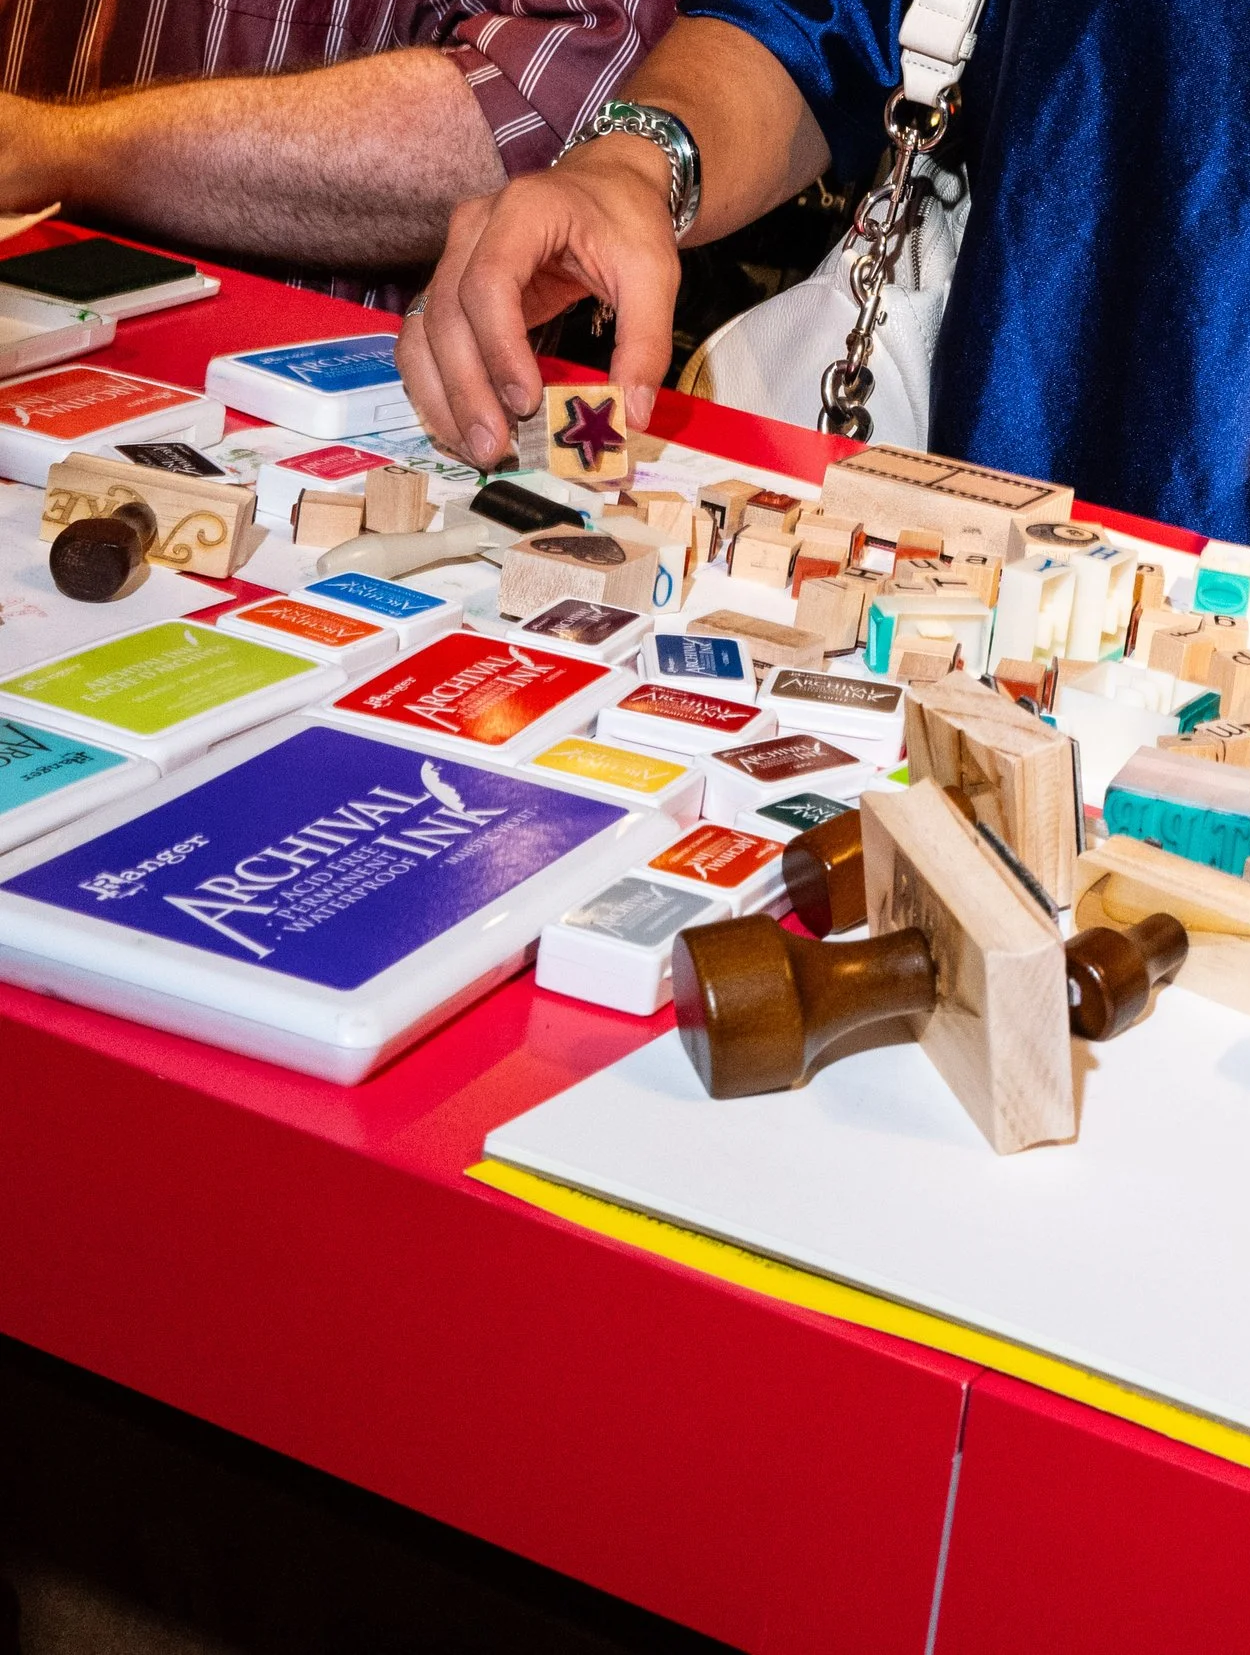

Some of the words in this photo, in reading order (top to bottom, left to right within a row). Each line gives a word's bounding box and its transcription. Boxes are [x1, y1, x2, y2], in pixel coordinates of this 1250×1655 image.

[287, 349, 395, 383] ARCHIVA
[33, 375, 145, 418] ARCHIVAL
[338, 584, 430, 611] ARCHIVAL
[496, 662, 556, 688] INK
[682, 642, 718, 677] ARCHIVAL
[363, 675, 417, 709] Ranger
[404, 655, 518, 733] ARCHIVAL
[780, 677, 875, 694] ARCHIVAL
[844, 690, 879, 702] INK
[631, 691, 730, 715] ARCHIVAL
[694, 708, 728, 722] INK
[20, 751, 95, 781] Ranger
[738, 744, 814, 773] ARCHIVAL
[794, 750, 828, 760] INK
[373, 807, 508, 859] INK
[444, 831, 497, 865] MAJESTIC
[497, 809, 535, 835] VIOLET
[79, 833, 210, 901] Ranger
[703, 830, 757, 872] ARCHIVAL
[163, 786, 434, 960] ARCHIVAL
[277, 851, 399, 920] PERMANENT
[280, 870, 334, 904] ACID
[329, 845, 381, 875] FREE
[284, 856, 419, 934] WATERPROOF
